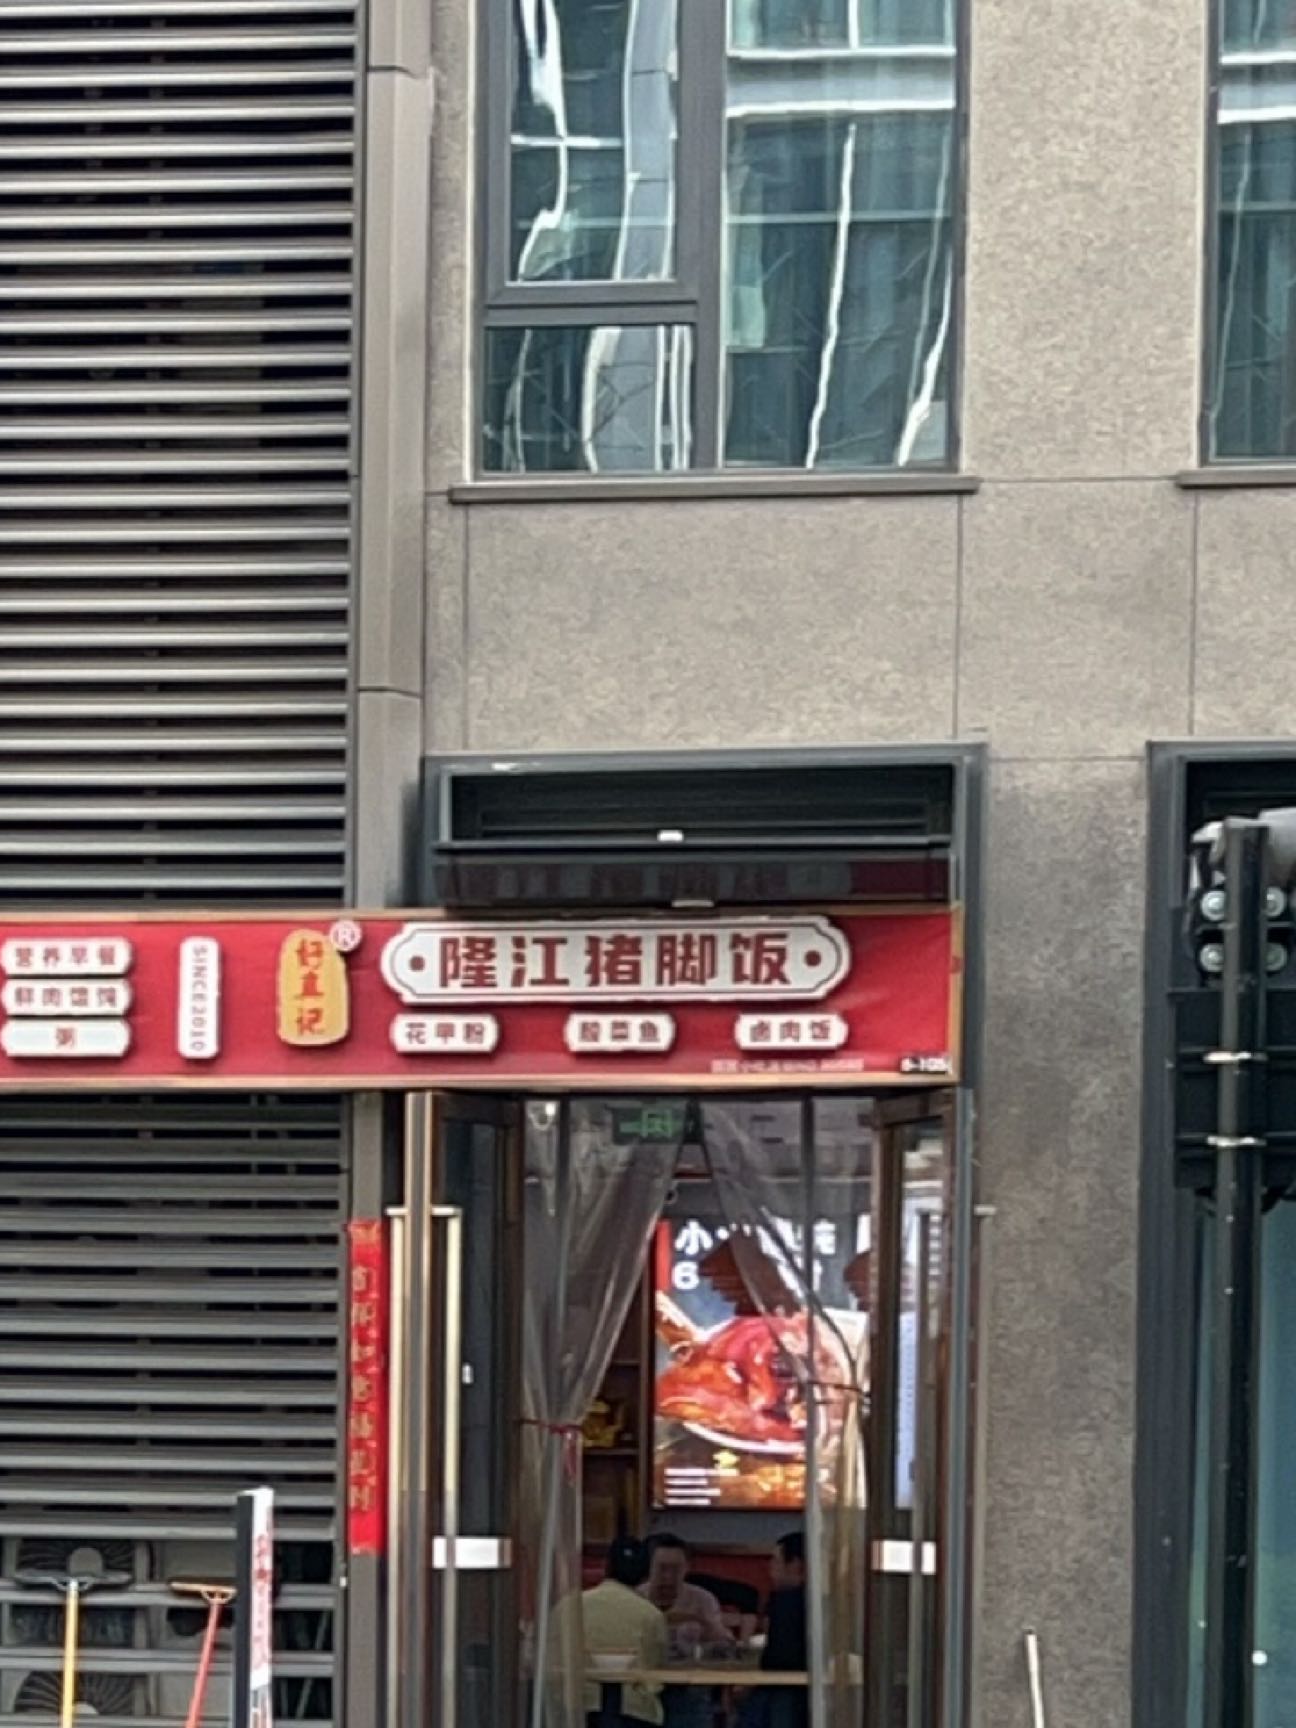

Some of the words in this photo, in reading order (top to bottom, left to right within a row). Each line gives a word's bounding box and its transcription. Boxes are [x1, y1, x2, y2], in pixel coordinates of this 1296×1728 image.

[192, 946, 206, 1000] SINCE
[438, 934, 790, 988] 隆江猪脚饭
[191, 1006, 205, 1052] 2010
[406, 1022, 484, 1044] 花甲粉
[580, 1020, 661, 1043] 酸菜鱼
[749, 1020, 831, 1043] 卤肉饭
